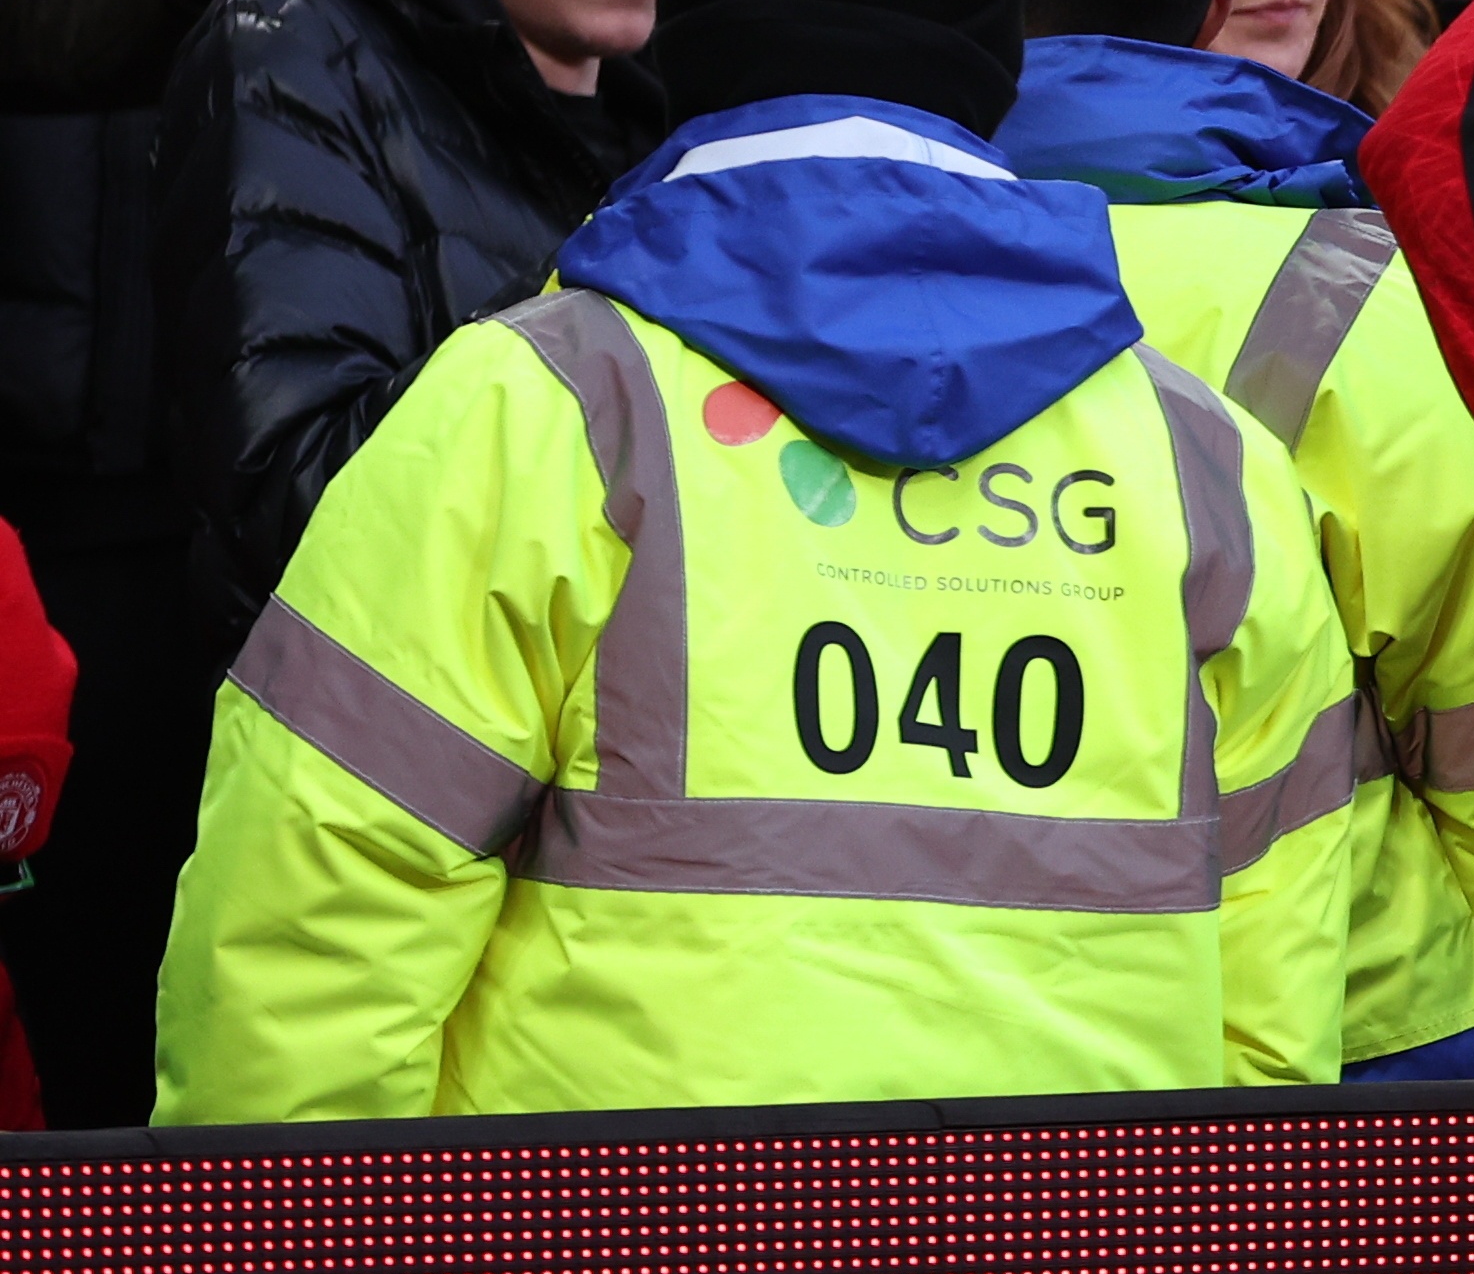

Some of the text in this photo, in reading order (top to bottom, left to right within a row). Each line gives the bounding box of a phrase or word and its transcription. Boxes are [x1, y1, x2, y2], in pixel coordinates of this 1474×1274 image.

[892, 463, 1116, 555] CSG
[816, 563, 1125, 601] CONTROLLED SOLUTIONS GROUP
[792, 620, 1085, 789] 040
